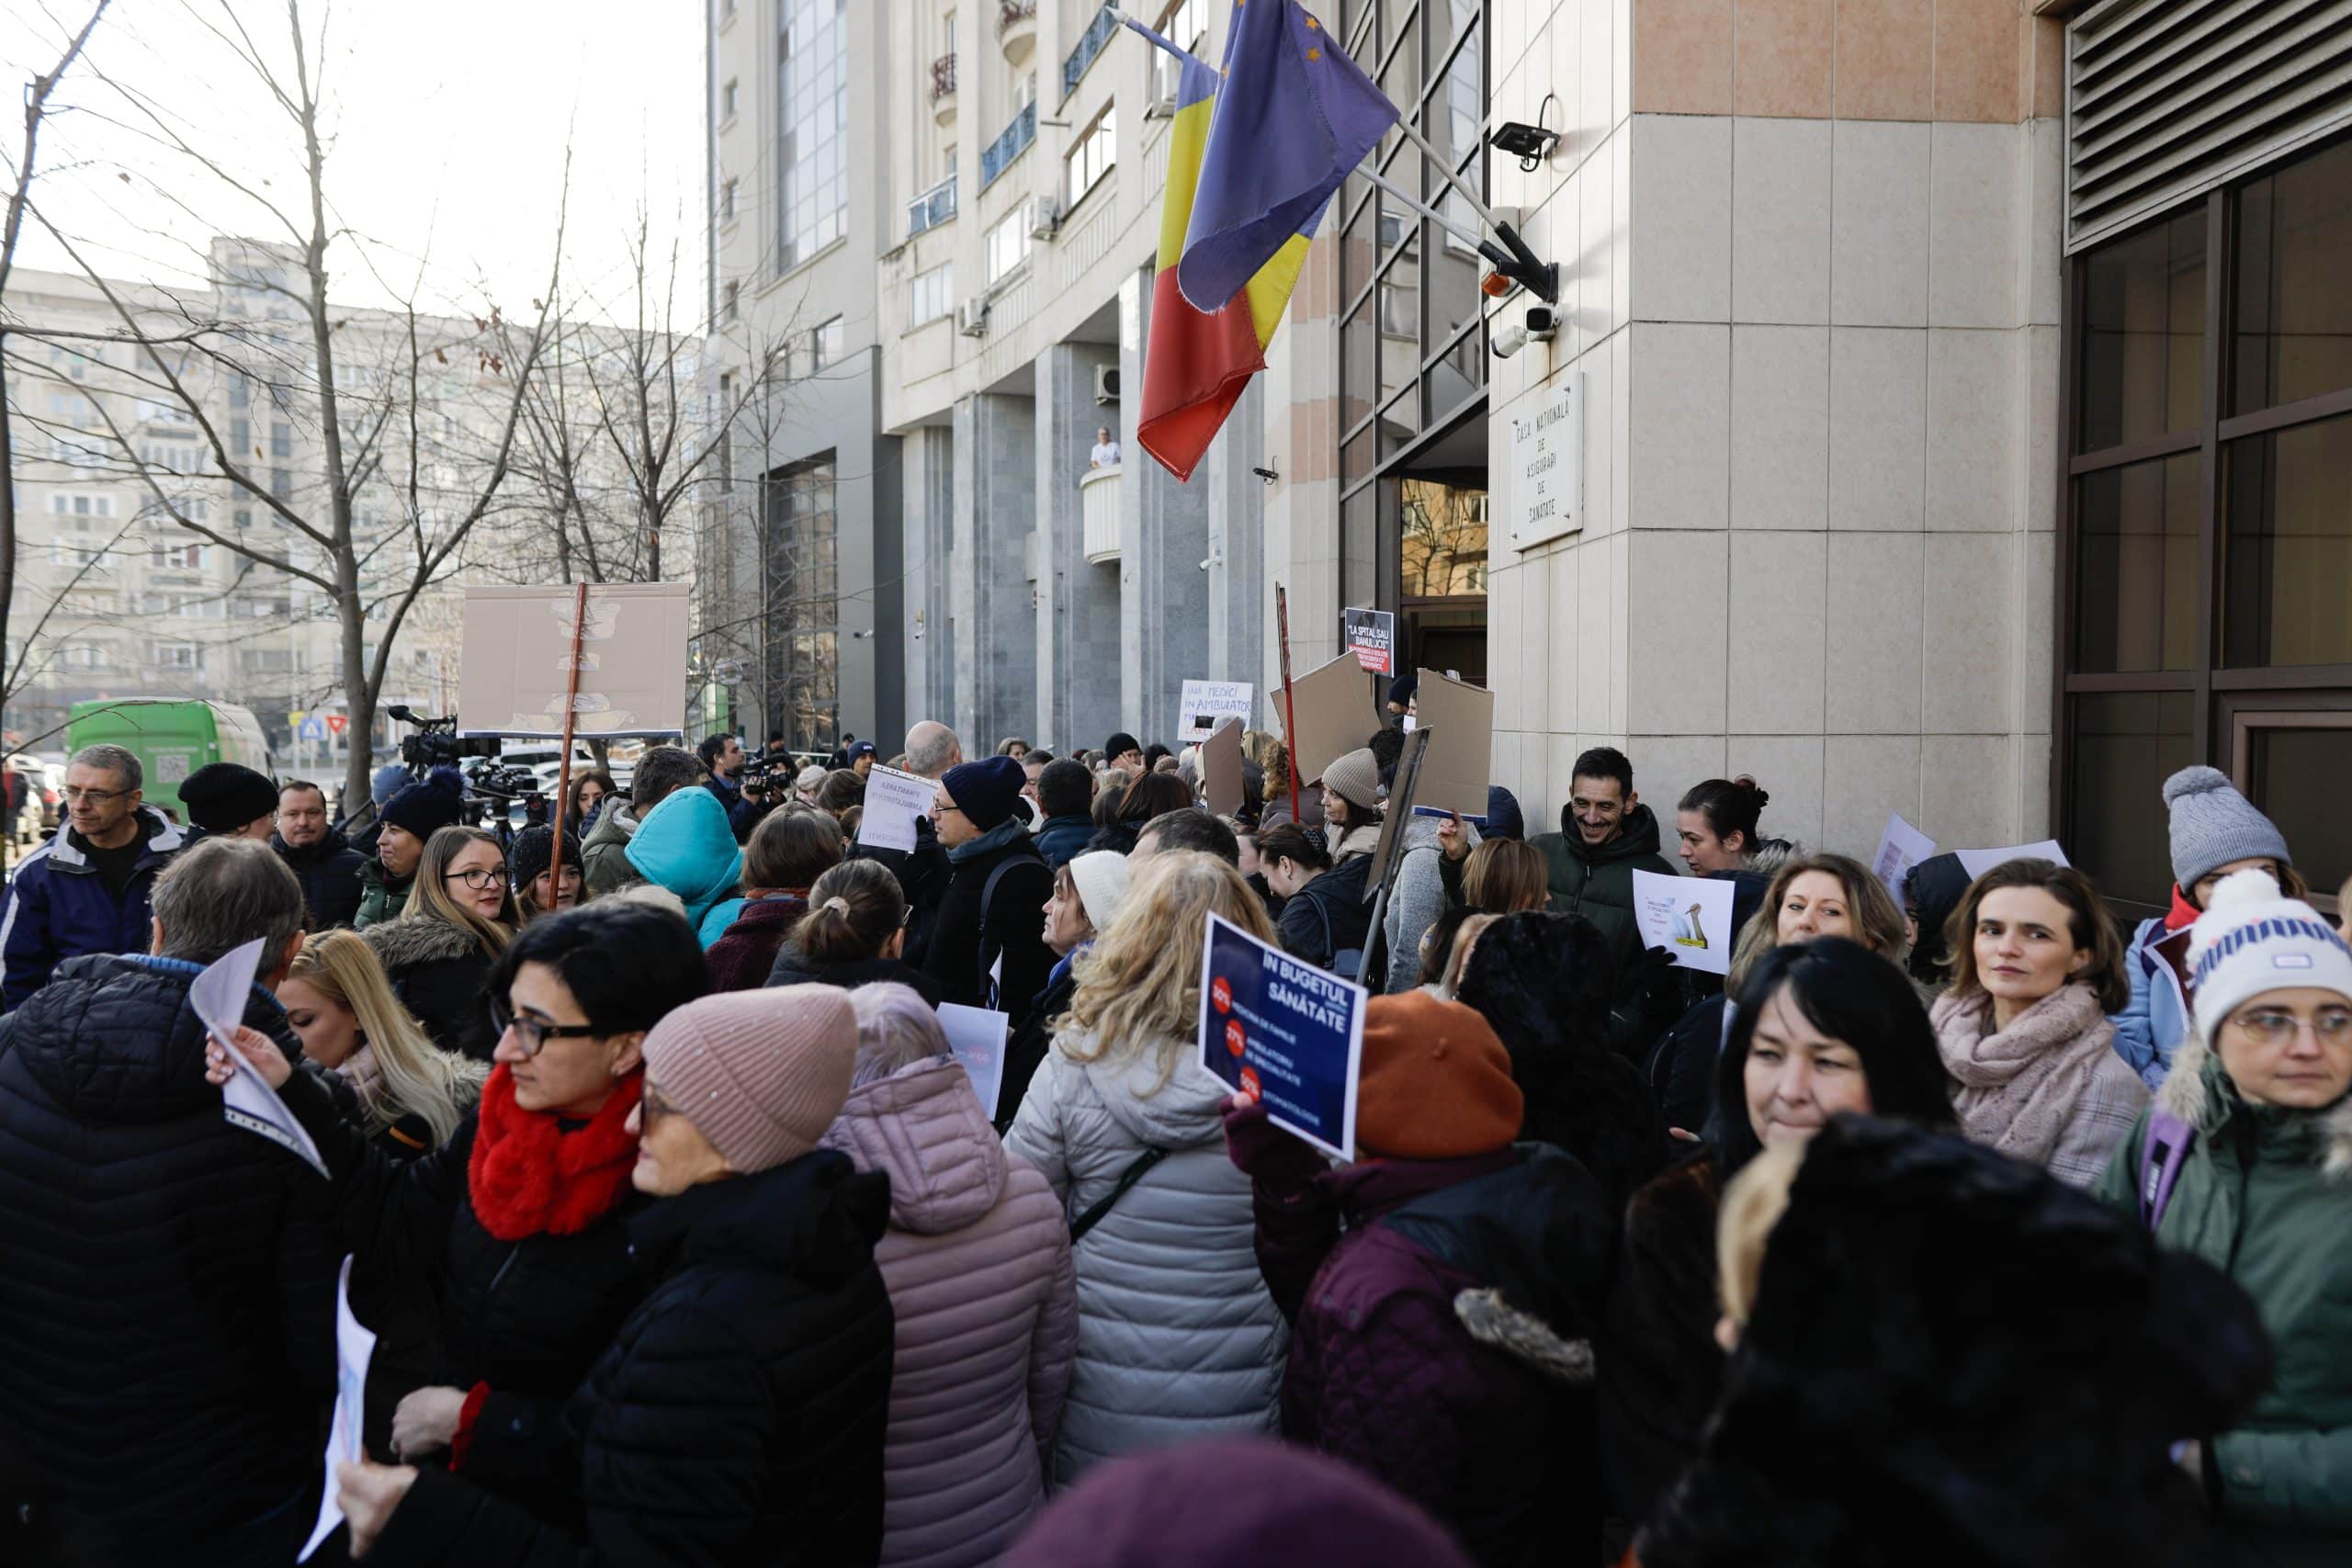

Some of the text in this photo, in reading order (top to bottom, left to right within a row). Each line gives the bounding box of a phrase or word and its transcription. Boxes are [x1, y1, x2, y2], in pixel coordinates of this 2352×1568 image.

[1516, 421, 1532, 444] CASA
[1537, 437, 1545, 453] DE
[1537, 480, 1545, 495] DE
[1358, 626, 1376, 637] SPITAL
[1376, 629, 1388, 639] SAU
[1355, 636, 1374, 648] BANUL
[1280, 960, 1348, 1007] BUGETUL
